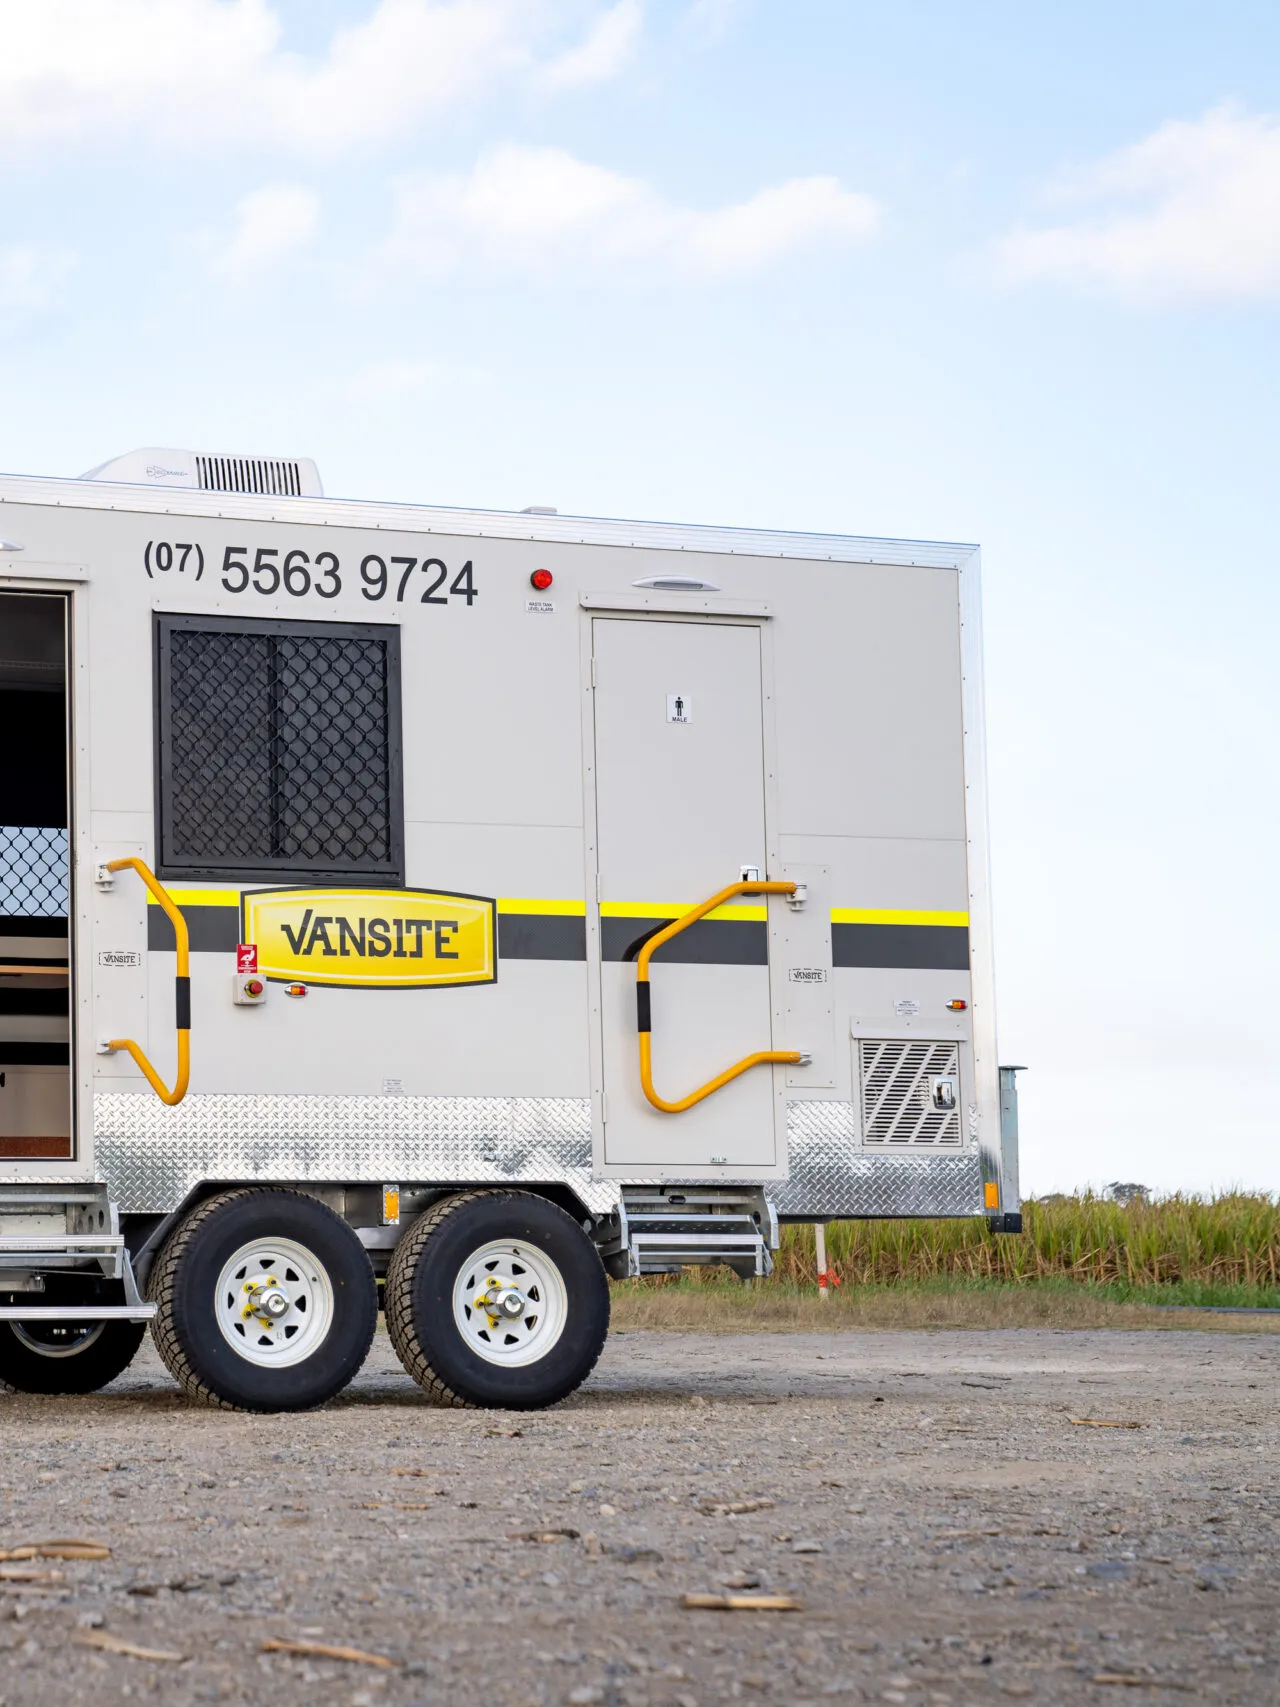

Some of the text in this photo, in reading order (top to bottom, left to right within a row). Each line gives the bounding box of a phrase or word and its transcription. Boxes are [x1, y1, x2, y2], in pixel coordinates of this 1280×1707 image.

[144, 541, 478, 606] (07) 5563 9724
[281, 909, 459, 959] VANSITE
[103, 954, 136, 963] VANSITE
[793, 971, 823, 980] VANSITE
